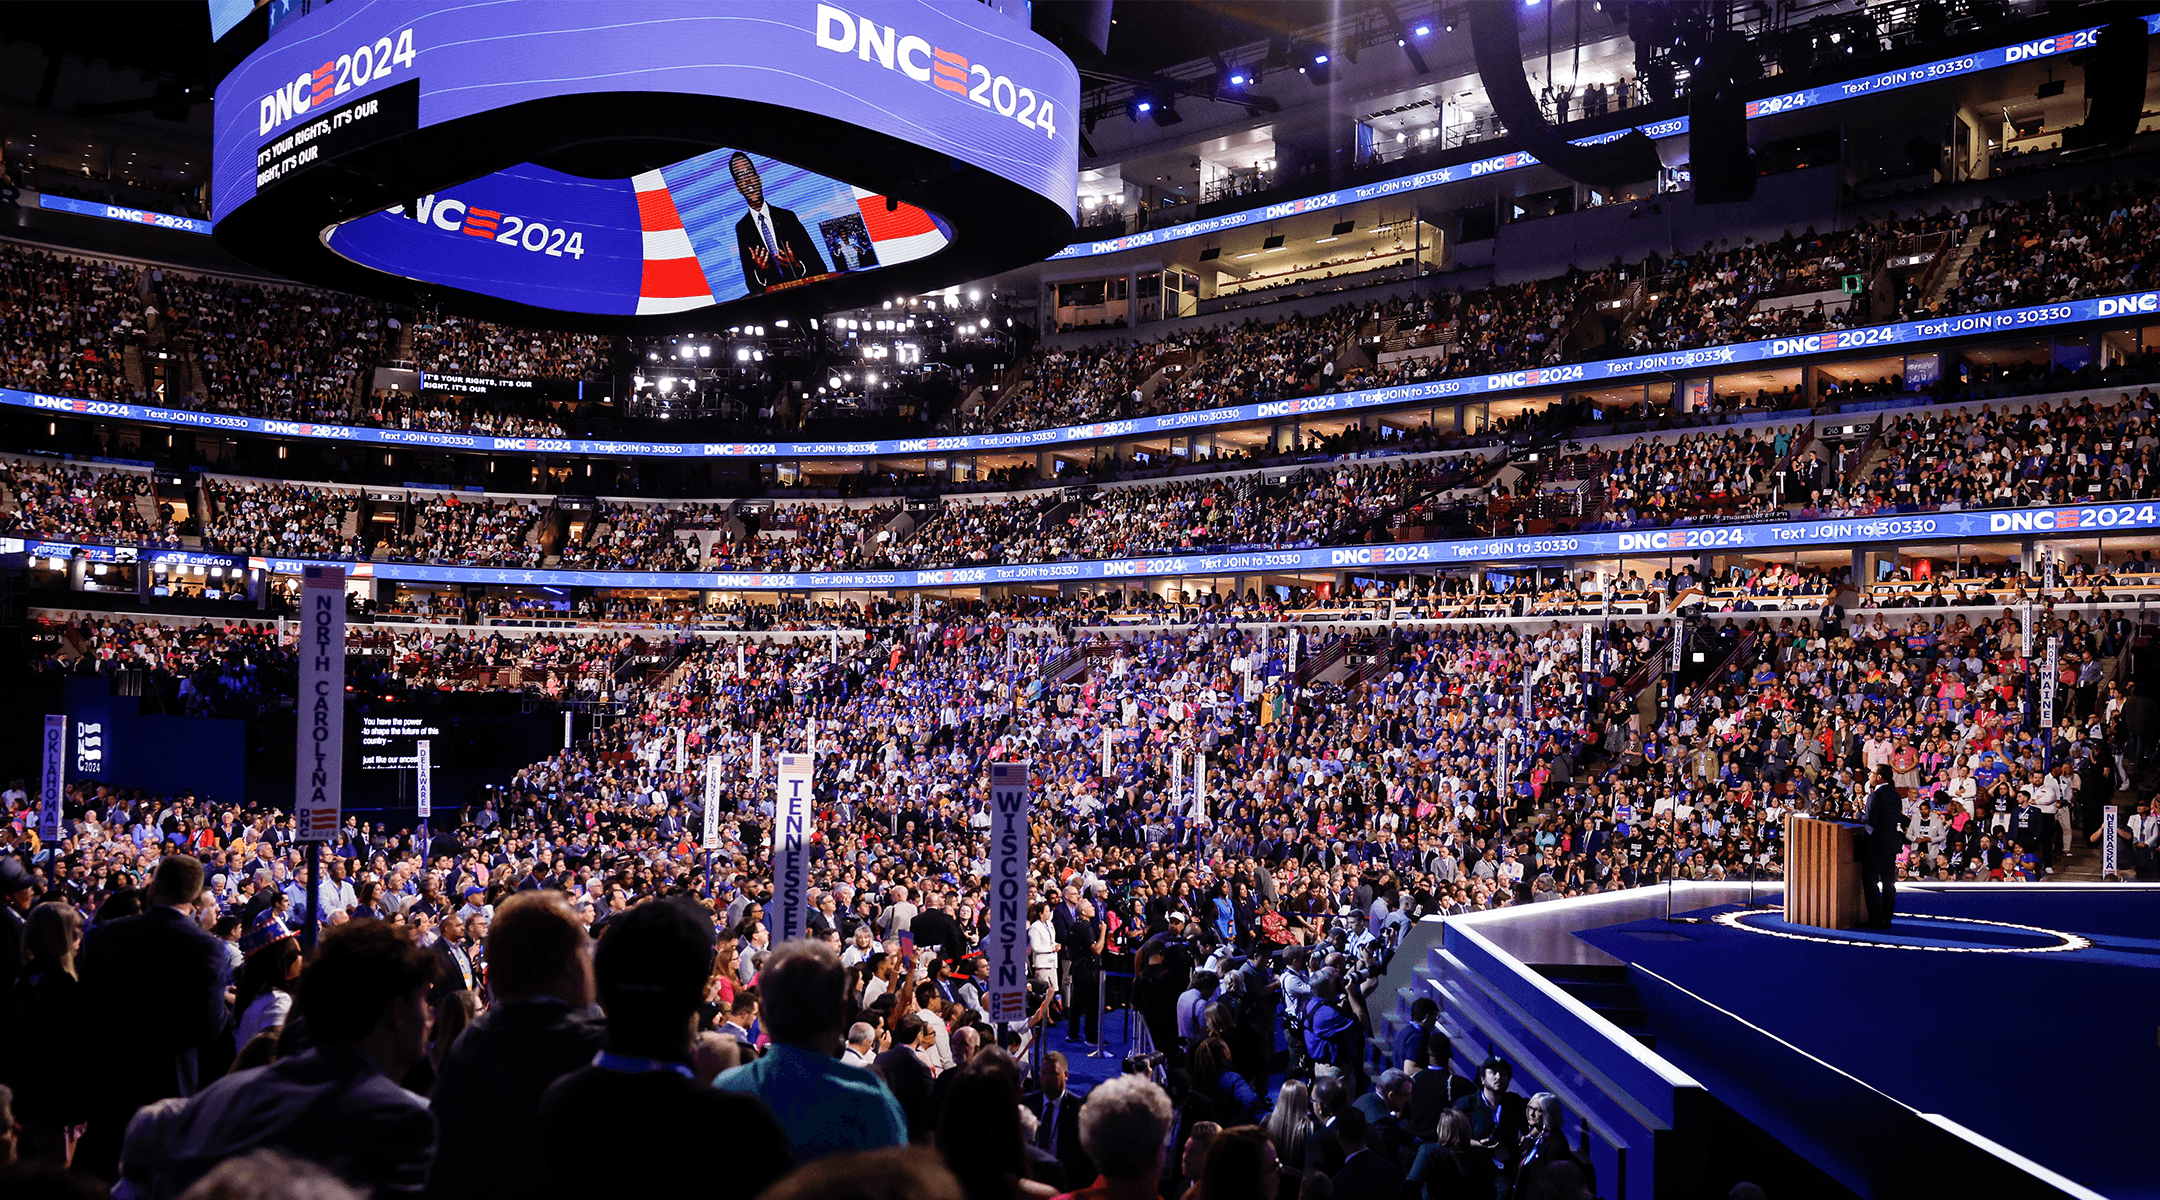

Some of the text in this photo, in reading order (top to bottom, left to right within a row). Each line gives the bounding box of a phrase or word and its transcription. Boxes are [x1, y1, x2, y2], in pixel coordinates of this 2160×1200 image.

[1842, 57, 1974, 95] Text JOIN 30330
[257, 99, 379, 168] IT'S YOUR RIGHTS, IT'S OUR
[1644, 120, 1682, 137] 30330
[256, 145, 319, 188] RIGHT, IT'S OUR
[1355, 173, 1444, 198] Text JOIN 30330
[1220, 214, 1247, 227] 30330
[1914, 306, 2072, 336] Text JOIN 30330
[1607, 348, 1730, 374] Text JOIN 30330
[423, 373, 439, 381] IT'S
[440, 375, 464, 383] YOUR
[465, 377, 497, 387] RIGHTS,
[515, 380, 533, 388] OUR
[423, 382, 450, 391] RIGHT,
[469, 385, 487, 393] OUR
[1382, 387, 1410, 401] JOIN
[1424, 381, 1460, 395] 30330
[144, 408, 249, 428] Text JOIN 30330
[1156, 408, 1240, 427] Text JOIN 30330
[379, 431, 474, 446] Text JOIN 30330
[615, 443, 639, 452] JOIN
[652, 445, 683, 454] 30330
[792, 444, 812, 453] Text
[813, 444, 835, 453] JOIN
[980, 431, 1057, 446] Text JOIN 30330
[1771, 519, 1937, 540] Text JOIN 30330
[1451, 538, 1578, 557] Text JOIN 30330
[190, 556, 232, 567] CHICAGO
[996, 565, 1079, 578] Text JOIN 30330
[1200, 554, 1301, 569] Text JOIN 30330
[2045, 549, 2053, 589] HAWAII
[810, 574, 896, 585] Text JOIN 30330
[1583, 629, 1591, 665] ALASKA
[1673, 626, 1682, 665] VERMONT
[310, 594, 332, 802] NORTH CAROLINA
[2042, 671, 2052, 719] MAINE
[363, 717, 423, 727] You have the power
[370, 728, 390, 736] shape
[390, 727, 401, 735] the
[401, 727, 420, 735] future
[420, 727, 427, 735] of
[427, 727, 440, 735] this
[77, 722, 85, 772] DNC
[363, 737, 387, 746] country
[84, 761, 101, 773] 2024
[362, 755, 375, 765] just
[375, 755, 387, 763] like
[44, 729, 59, 823] OKLAHOMA
[419, 749, 428, 806] DELAWARE
[707, 766, 717, 835] PENNSYLVANIA
[300, 807, 310, 838] DNC
[2106, 813, 2115, 870] NEBRASKA
[783, 779, 804, 943] TENNESSEE
[996, 791, 1023, 987] WISCONSIN
[992, 992, 1000, 1020] DNC
